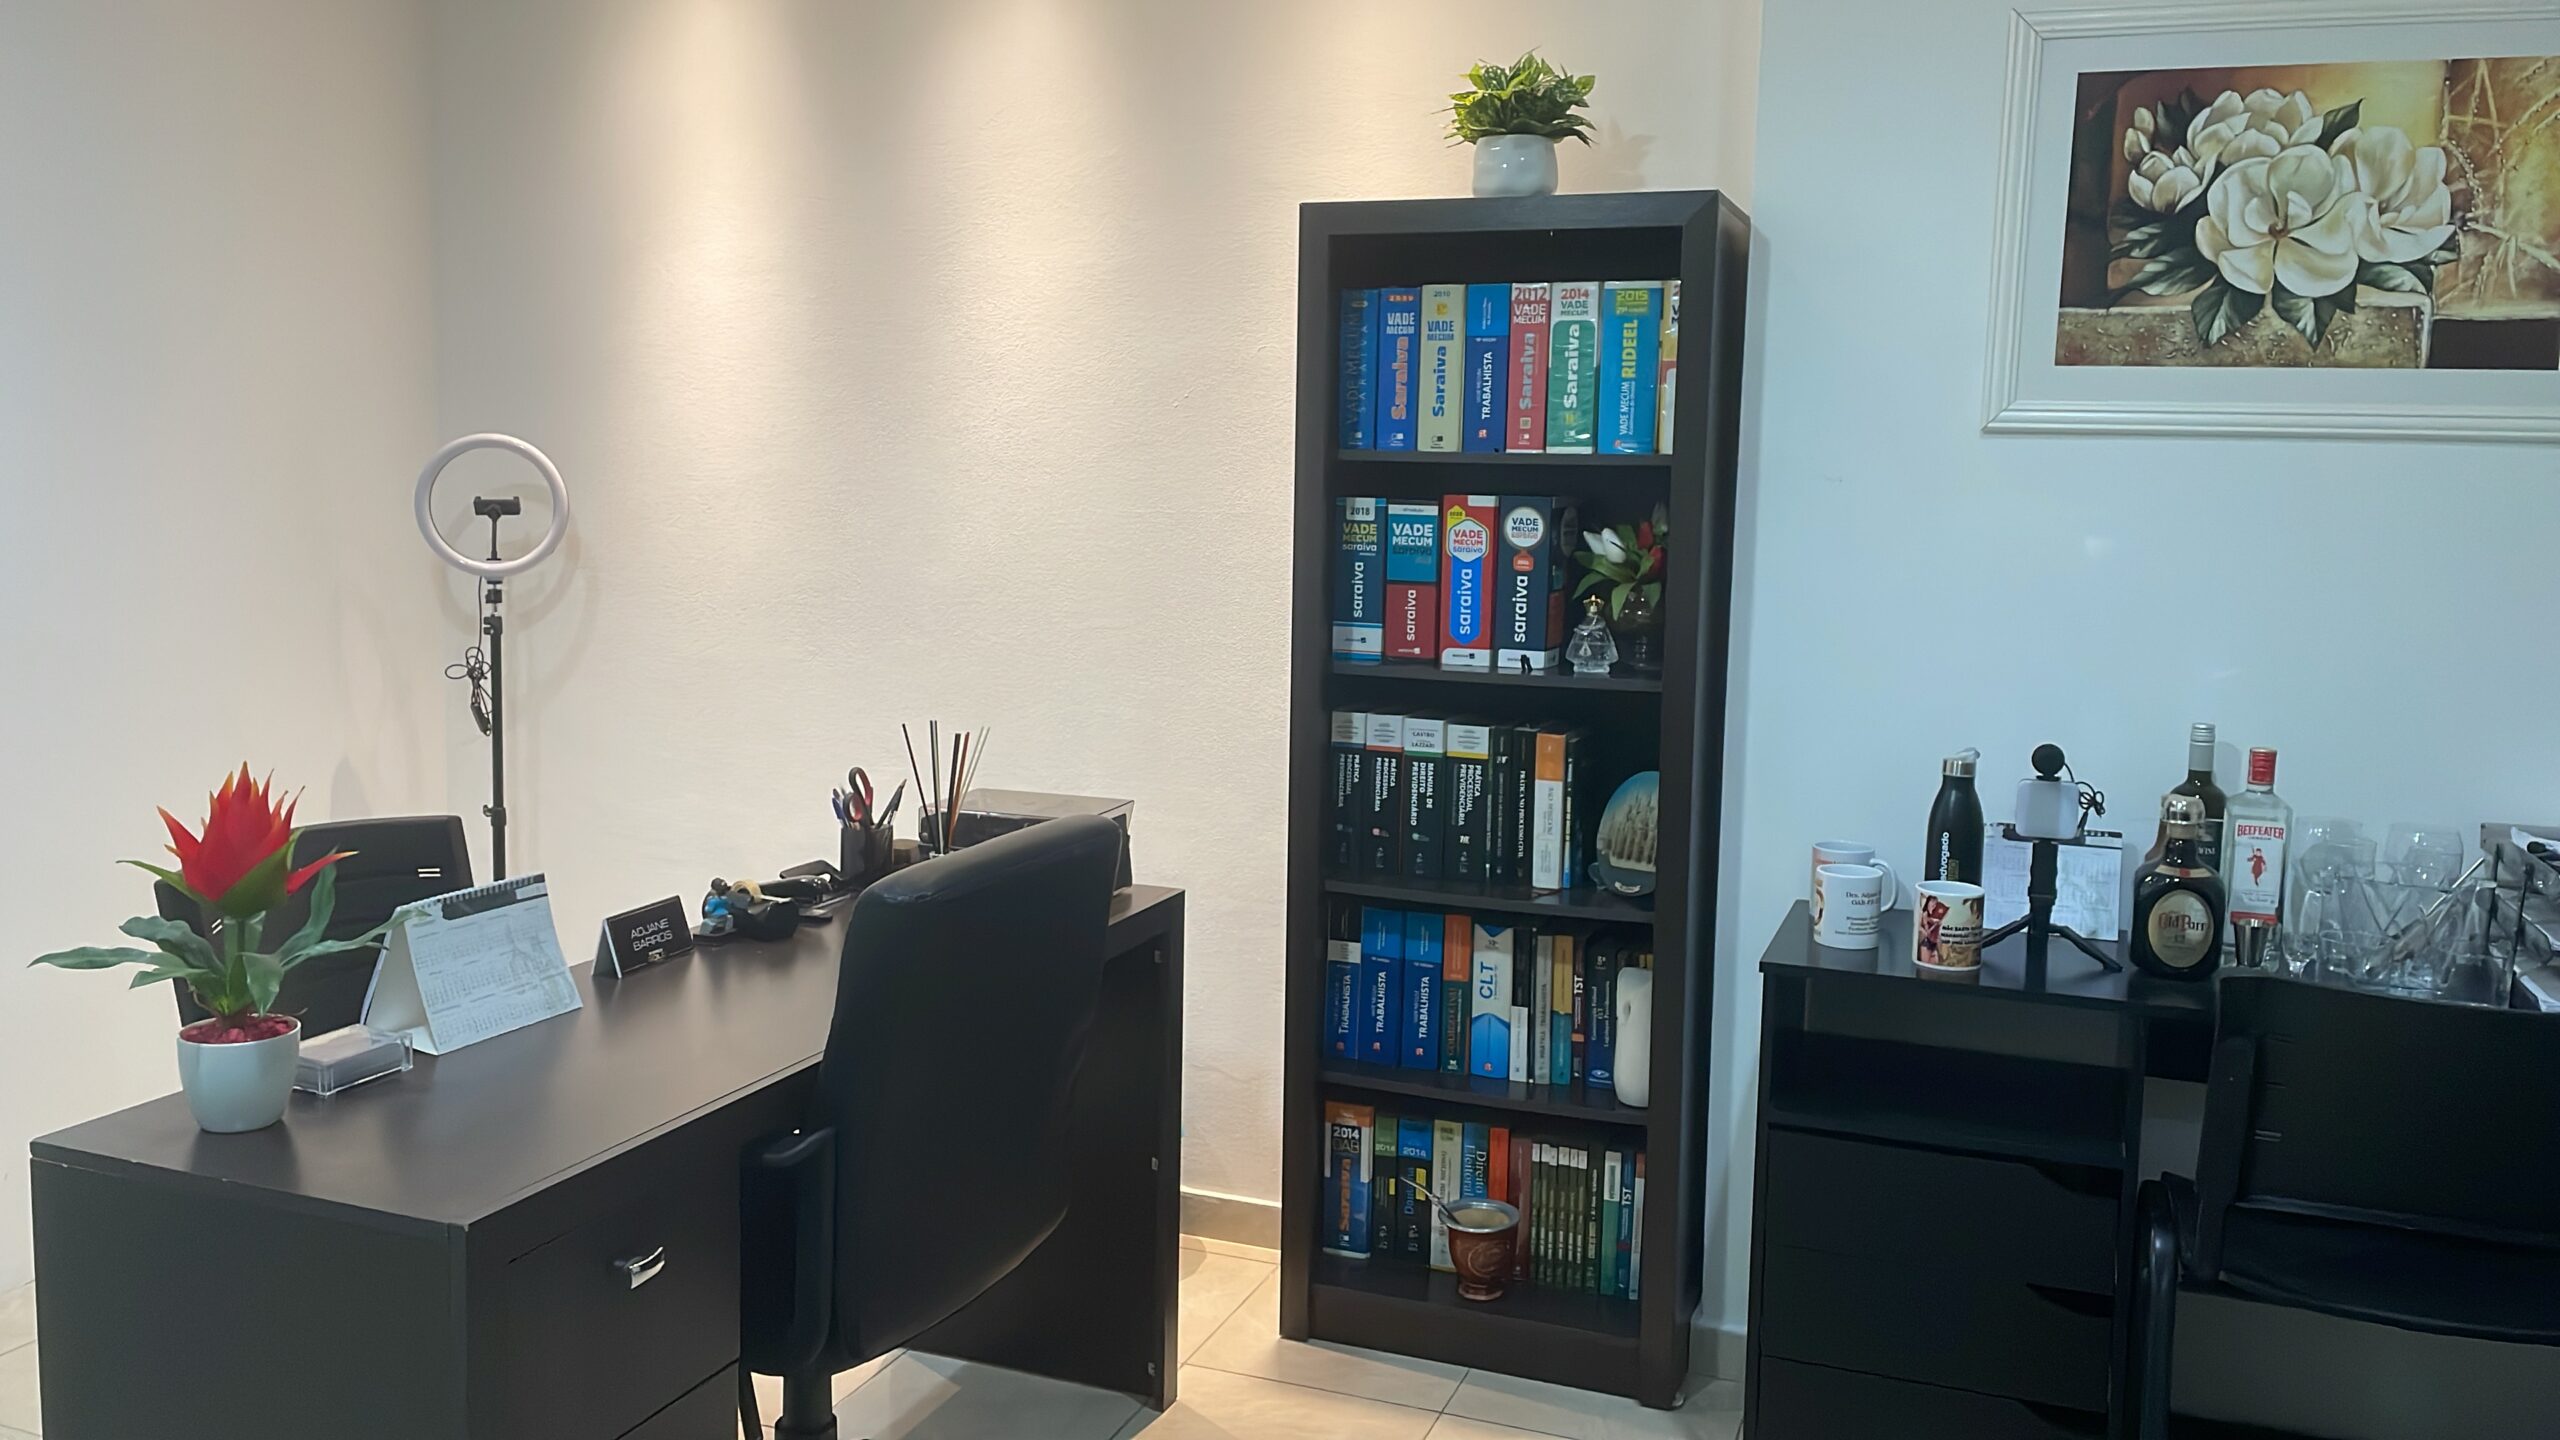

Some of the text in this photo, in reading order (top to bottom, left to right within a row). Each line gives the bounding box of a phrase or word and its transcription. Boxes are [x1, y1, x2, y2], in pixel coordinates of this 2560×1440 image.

[1514, 287, 1547, 301] 2012
[1560, 288, 1590, 300] 2014
[1617, 290, 1648, 301] 2015
[1513, 303, 1547, 316] VADE
[1560, 300, 1589, 309] VADE
[1560, 309, 1589, 317] MECUM
[1387, 312, 1416, 325] VADE
[1427, 320, 1454, 332] VADE
[1513, 315, 1546, 324] MECUM
[1386, 325, 1415, 334] MECUM
[1621, 319, 1638, 378] RIDEEL
[1519, 332, 1536, 410] Saraiva
[1563, 323, 1580, 409] Saraiva
[1391, 336, 1409, 420] Saraiva
[1432, 345, 1447, 417] Saraiva
[1481, 351, 1493, 420] TRABALHISTA
[1620, 381, 1631, 412] MECUM
[1619, 414, 1629, 435] VADE
[1350, 507, 1370, 516] 2018
[1512, 517, 1539, 526] VADE
[1342, 534, 1377, 543] MECUM
[1343, 523, 1377, 534] VADE
[1392, 522, 1434, 536] VADE
[1454, 529, 1483, 539] VADE
[1342, 542, 1377, 552] saraiva
[1392, 536, 1433, 546] MECUM
[1453, 538, 1483, 546] MECUM
[1352, 561, 1364, 618] saraiva
[1458, 568, 1473, 635] saraiva
[1512, 575, 1528, 643] saraiva
[1404, 589, 1416, 641] saraiva
[1426, 762, 1434, 809] MANUAL DE
[1466, 764, 1474, 811] PROCESSUAL
[1474, 765, 1482, 797] PRÁTICA
[1410, 761, 1419, 826] PREVIDENCIÁRIO
[1458, 763, 1467, 826] PREVIDENCIÁRIA
[2237, 824, 2285, 840] BEEFEATER
[631, 918, 670, 939] ADJANE
[2159, 911, 2207, 932] Old Parr
[632, 930, 673, 952] BARROS
[1480, 961, 1494, 999] CLT
[1574, 975, 1584, 994] TST
[1338, 974, 1351, 1034] TRABALHISTA
[1376, 971, 1387, 1033] TRABALHISTA
[1419, 976, 1430, 1039] TRABALHISTA
[1333, 1126, 1360, 1140] 2014
[1333, 1139, 1360, 1153] OAB
[1375, 1143, 1396, 1152] 2014
[1403, 1146, 1427, 1157] 2014
[1463, 1145, 1476, 1196] Eleitoral
[1475, 1151, 1487, 1193] Direito
[1622, 1186, 1632, 1206] TST
